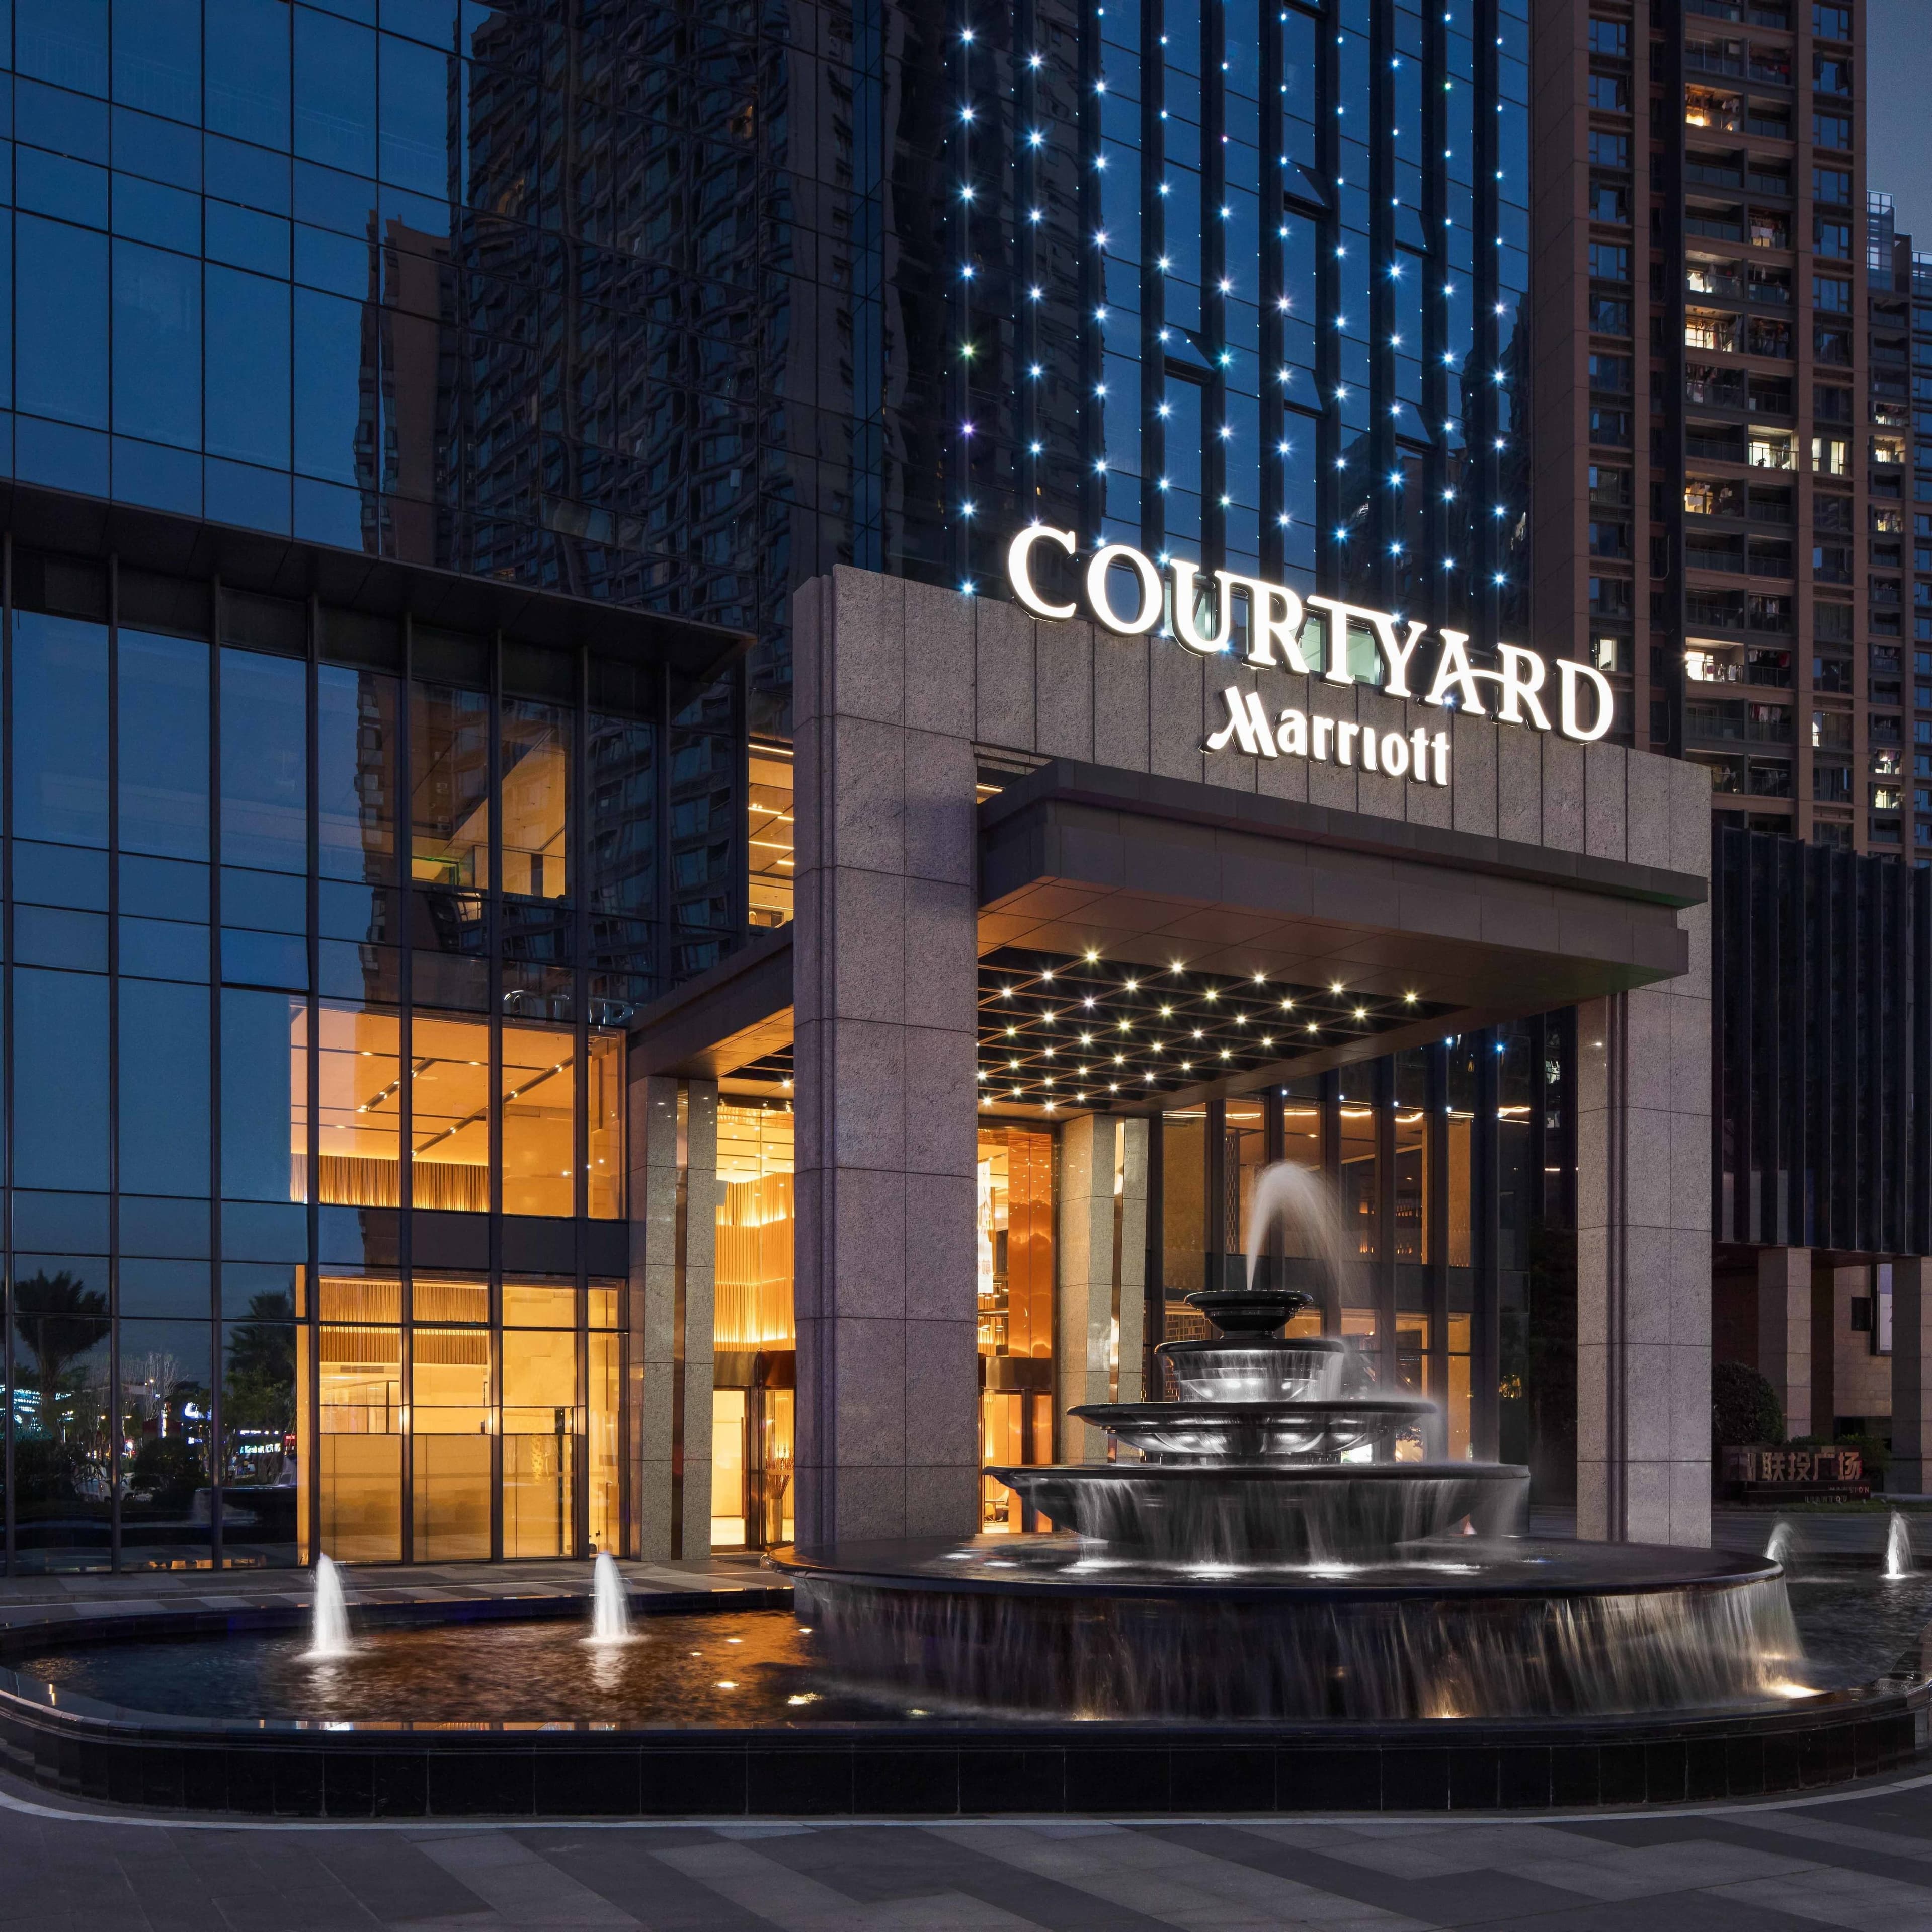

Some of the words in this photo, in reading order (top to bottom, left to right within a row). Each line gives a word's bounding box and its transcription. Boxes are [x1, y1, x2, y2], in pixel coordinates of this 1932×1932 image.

[1008, 521, 1614, 741] COURTYARD
[1206, 685, 1450, 786] Marriott
[1762, 1451, 1860, 1481] 联投广场
